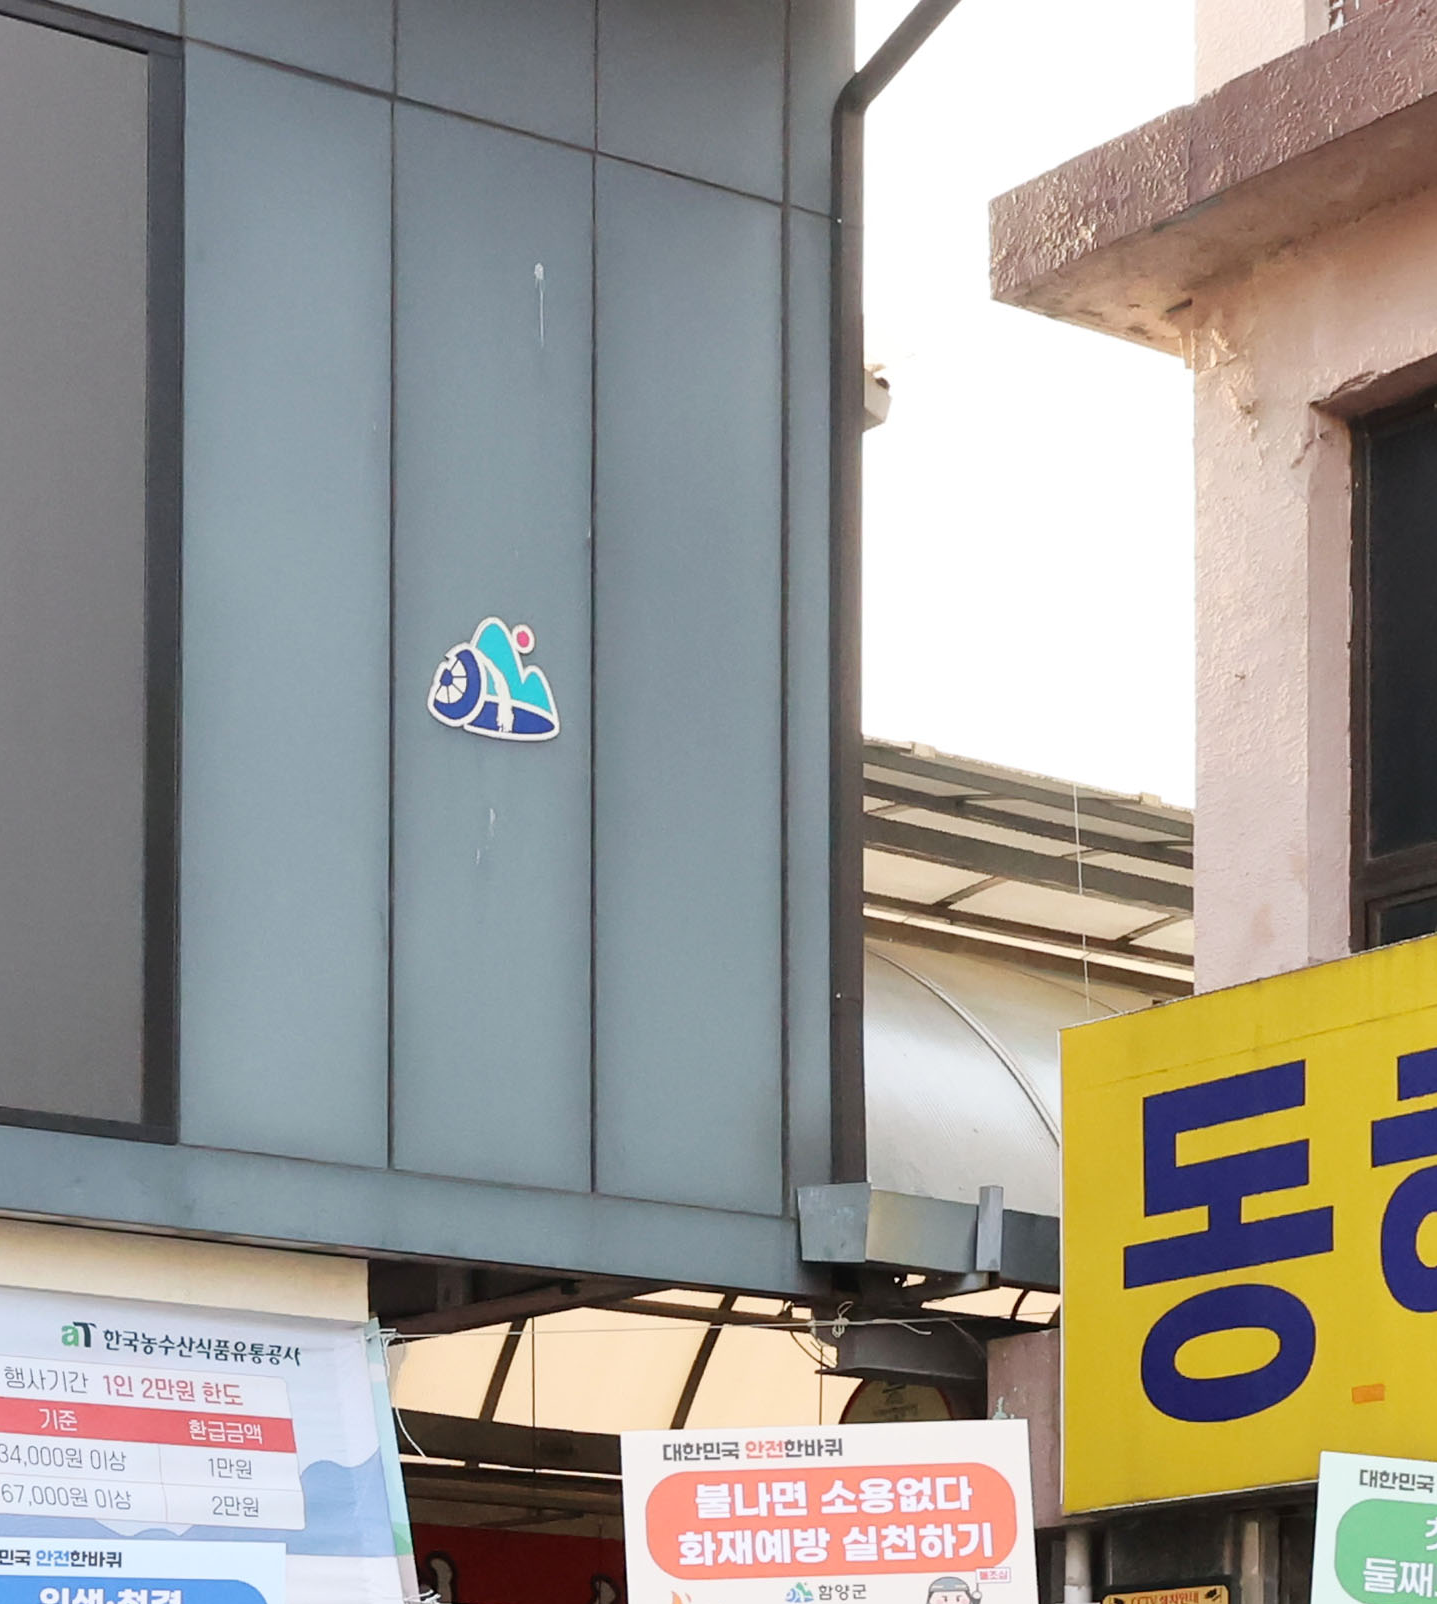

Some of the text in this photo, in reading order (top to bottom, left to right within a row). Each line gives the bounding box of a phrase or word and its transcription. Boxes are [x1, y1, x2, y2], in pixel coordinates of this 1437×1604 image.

[103, 1328, 302, 1368] 한국농수산식품유통공사
[4, 1365, 244, 1407] 행사기간 1인 2만원 한도
[38, 1407, 79, 1432] 기준
[188, 1418, 264, 1446] 환급금액
[91, 1446, 127, 1474] 이상
[662, 1437, 844, 1464] 대한민국 안전한바퀴
[208, 1456, 253, 1481] 1만원
[1359, 1468, 1435, 1495] 대한민국
[1, 1483, 132, 1512] 67,000원 이상
[211, 1493, 260, 1520] 2만원
[694, 1475, 973, 1519] 불나면 소용없다
[677, 1521, 994, 1568] 화재예방 실천하기
[35, 1549, 123, 1570] 안전한바퀴
[979, 1570, 1009, 1582] 불조심
[817, 1583, 867, 1602] 함양군
